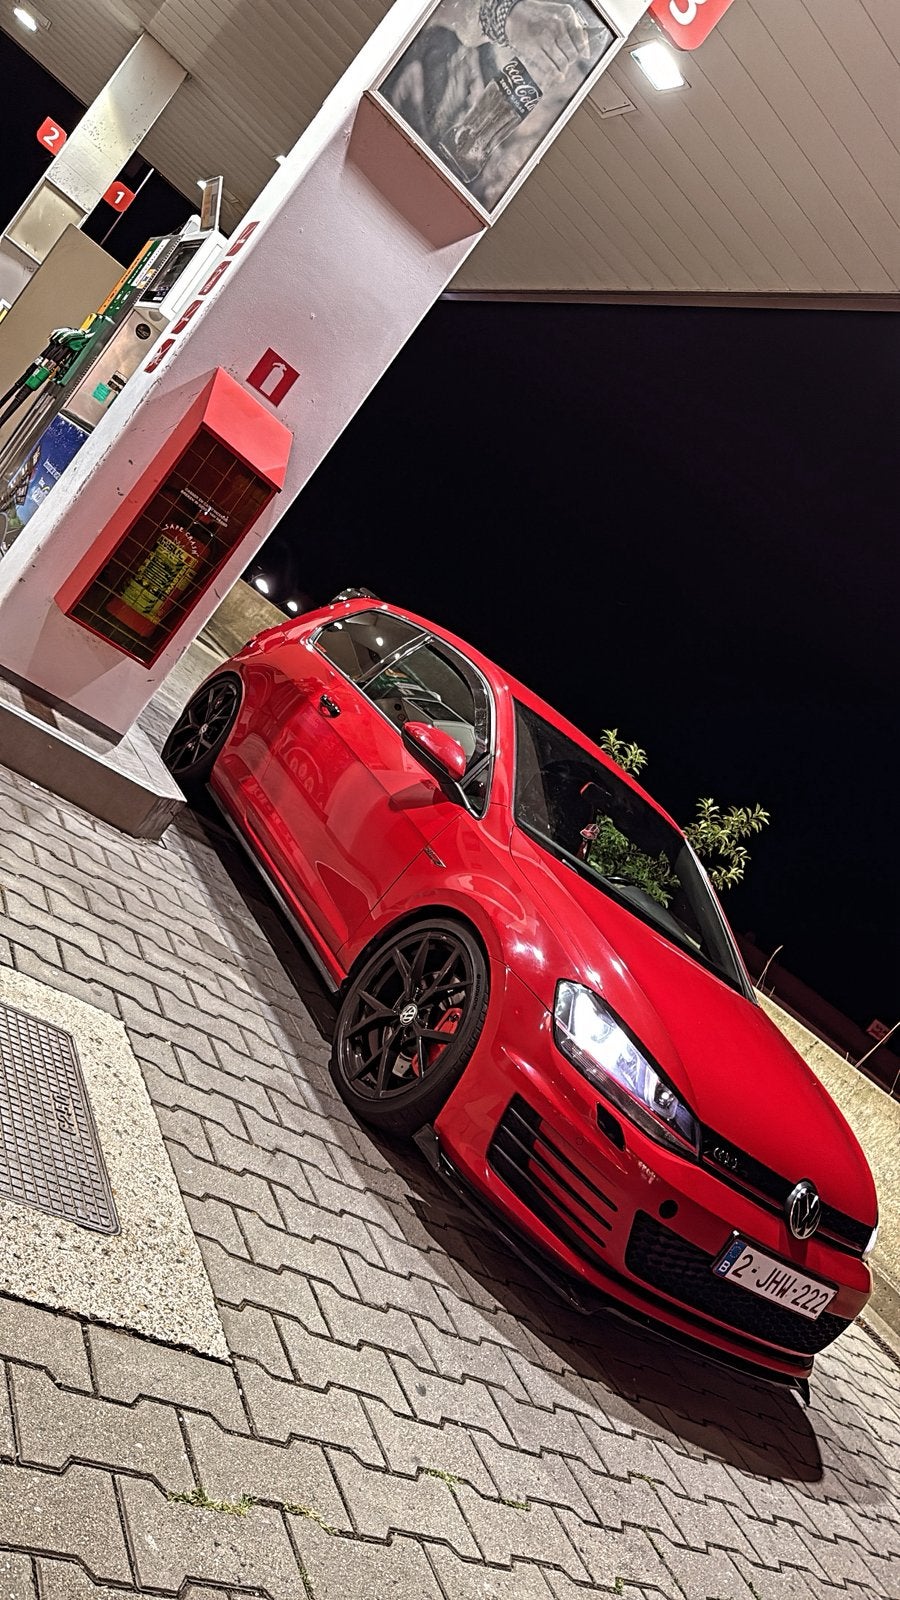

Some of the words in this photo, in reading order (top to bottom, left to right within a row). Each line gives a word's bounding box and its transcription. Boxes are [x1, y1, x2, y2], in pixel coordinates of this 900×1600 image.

[501, 61, 540, 112] Coca-Cola
[42, 126, 60, 148] 2
[114, 190, 125, 205] 1
[718, 1260, 731, 1273] B
